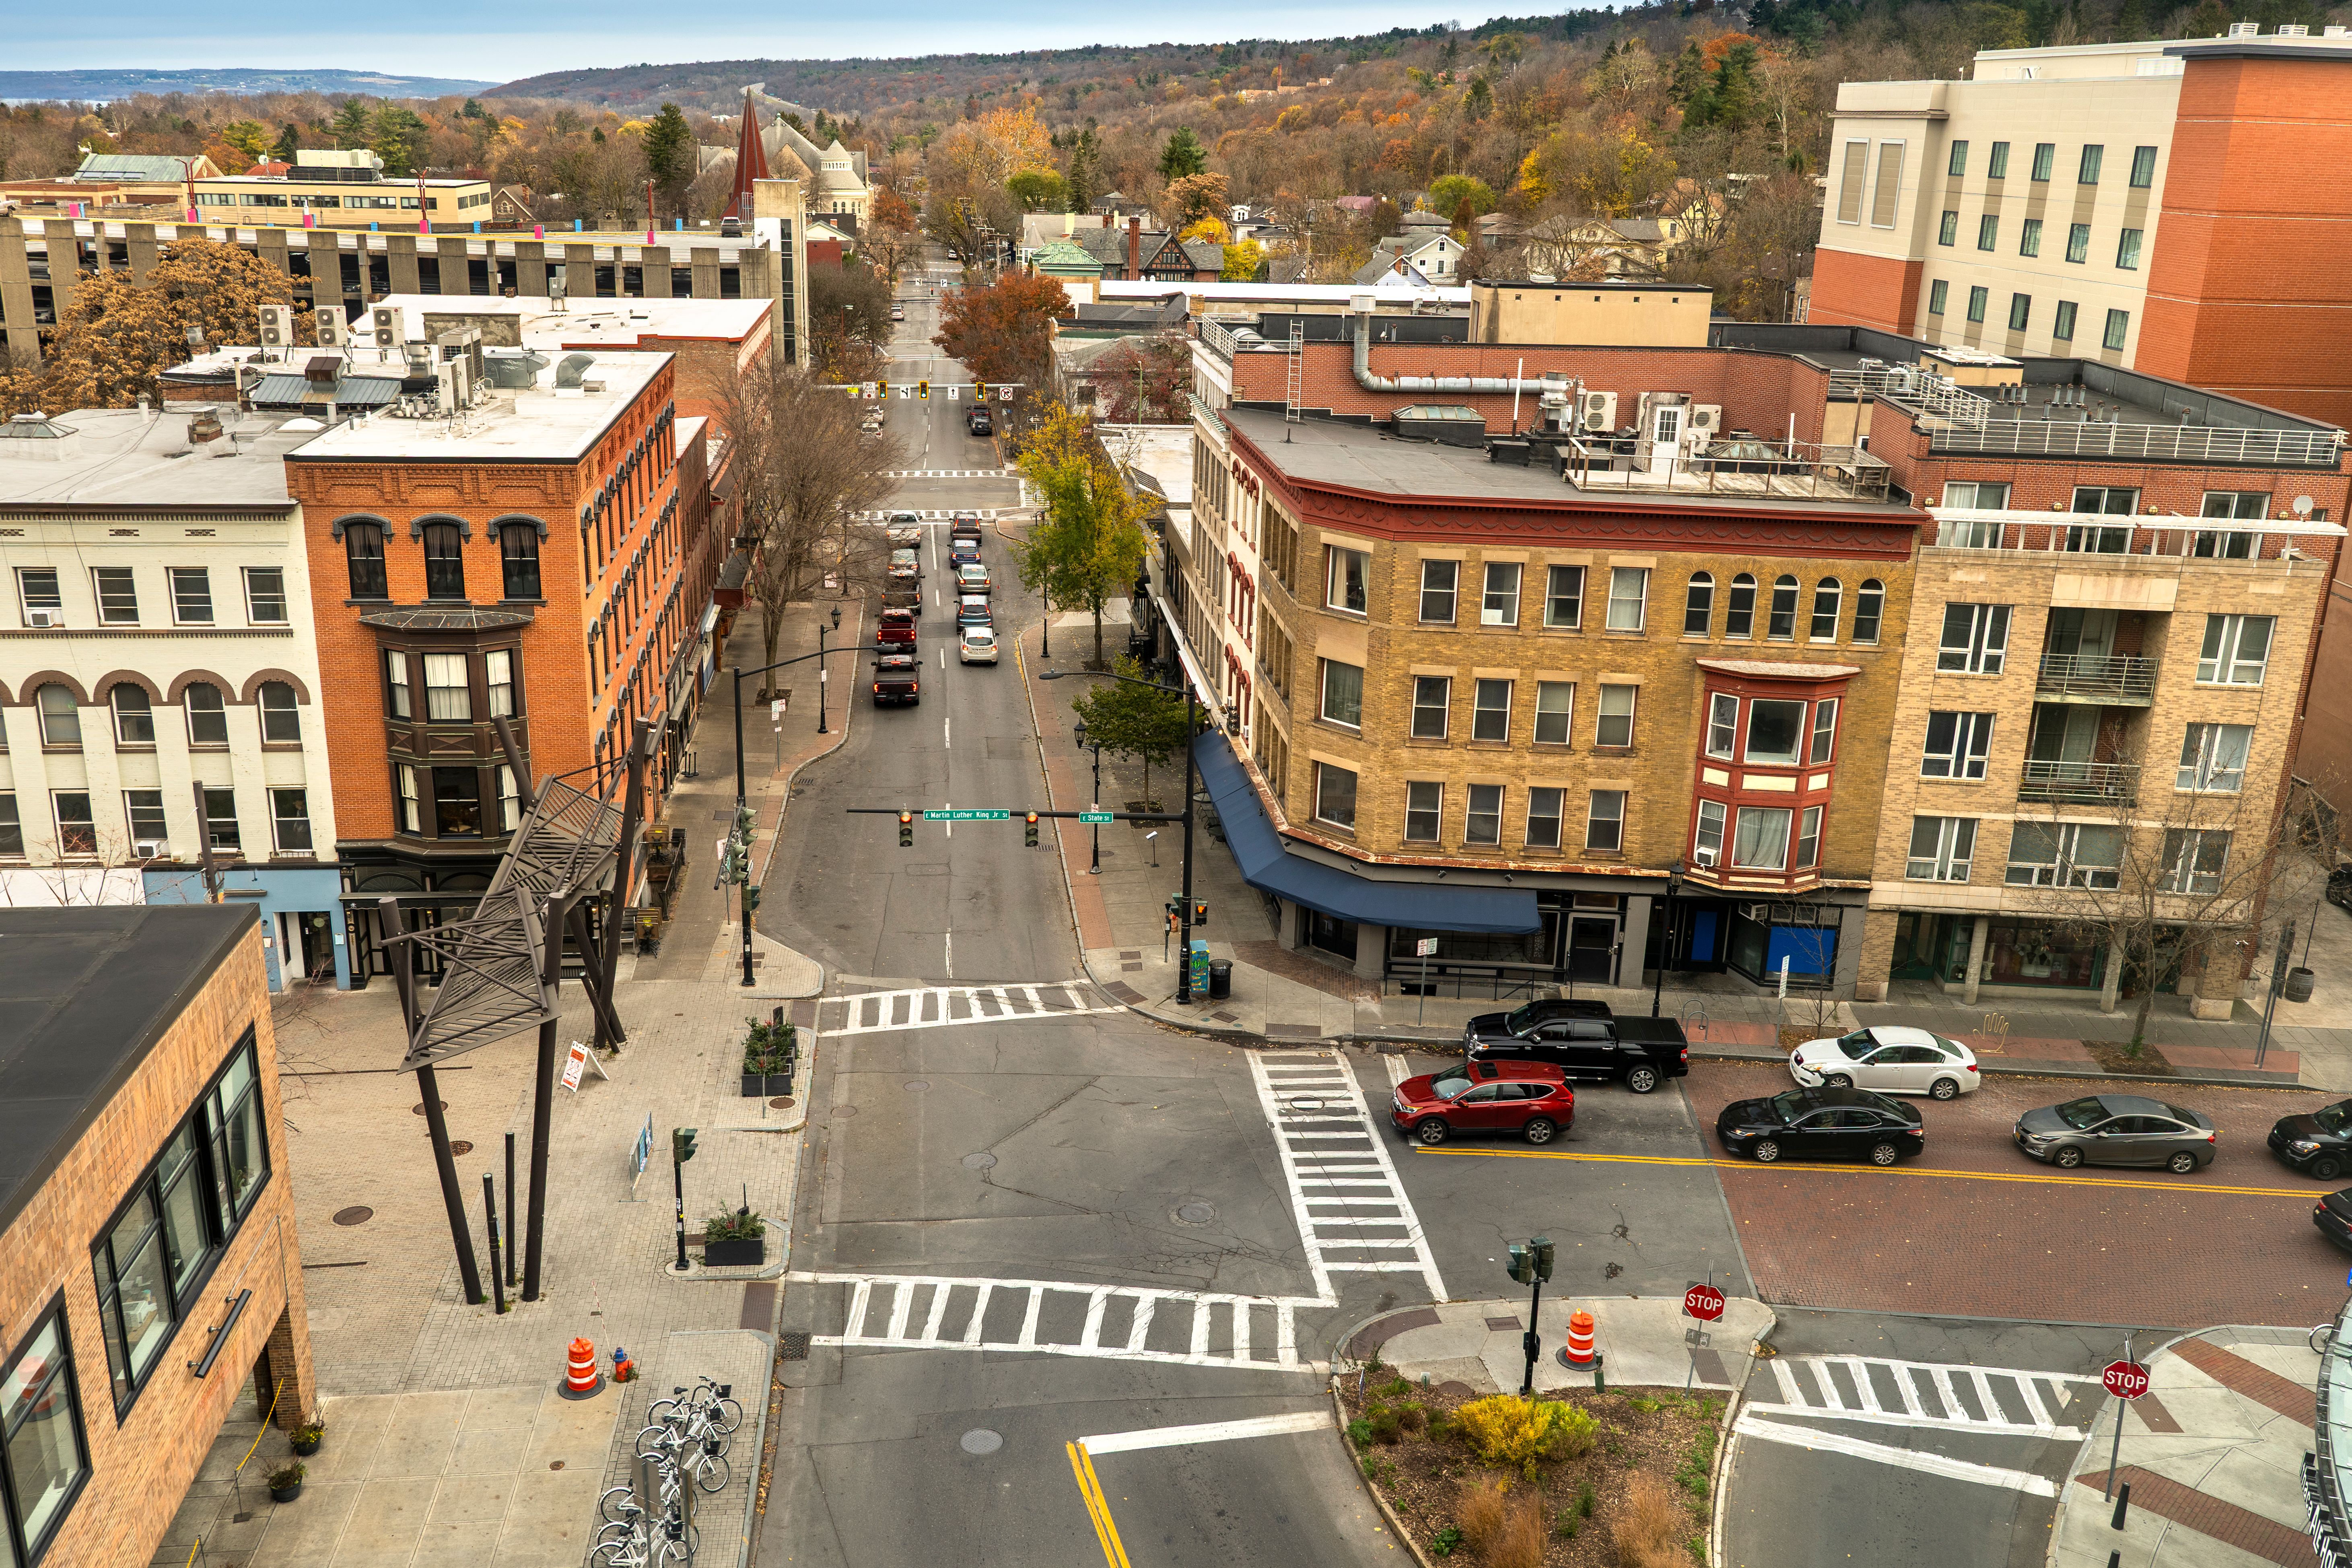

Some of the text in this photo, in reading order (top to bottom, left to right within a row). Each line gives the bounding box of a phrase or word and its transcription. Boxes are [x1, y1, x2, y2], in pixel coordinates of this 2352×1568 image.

[1687, 1294, 1722, 1311] STOP
[2105, 1370, 2146, 1389] STOP
[2300, 1449, 2313, 1520] Ithaca
[2309, 1504, 2323, 1555] ALE
